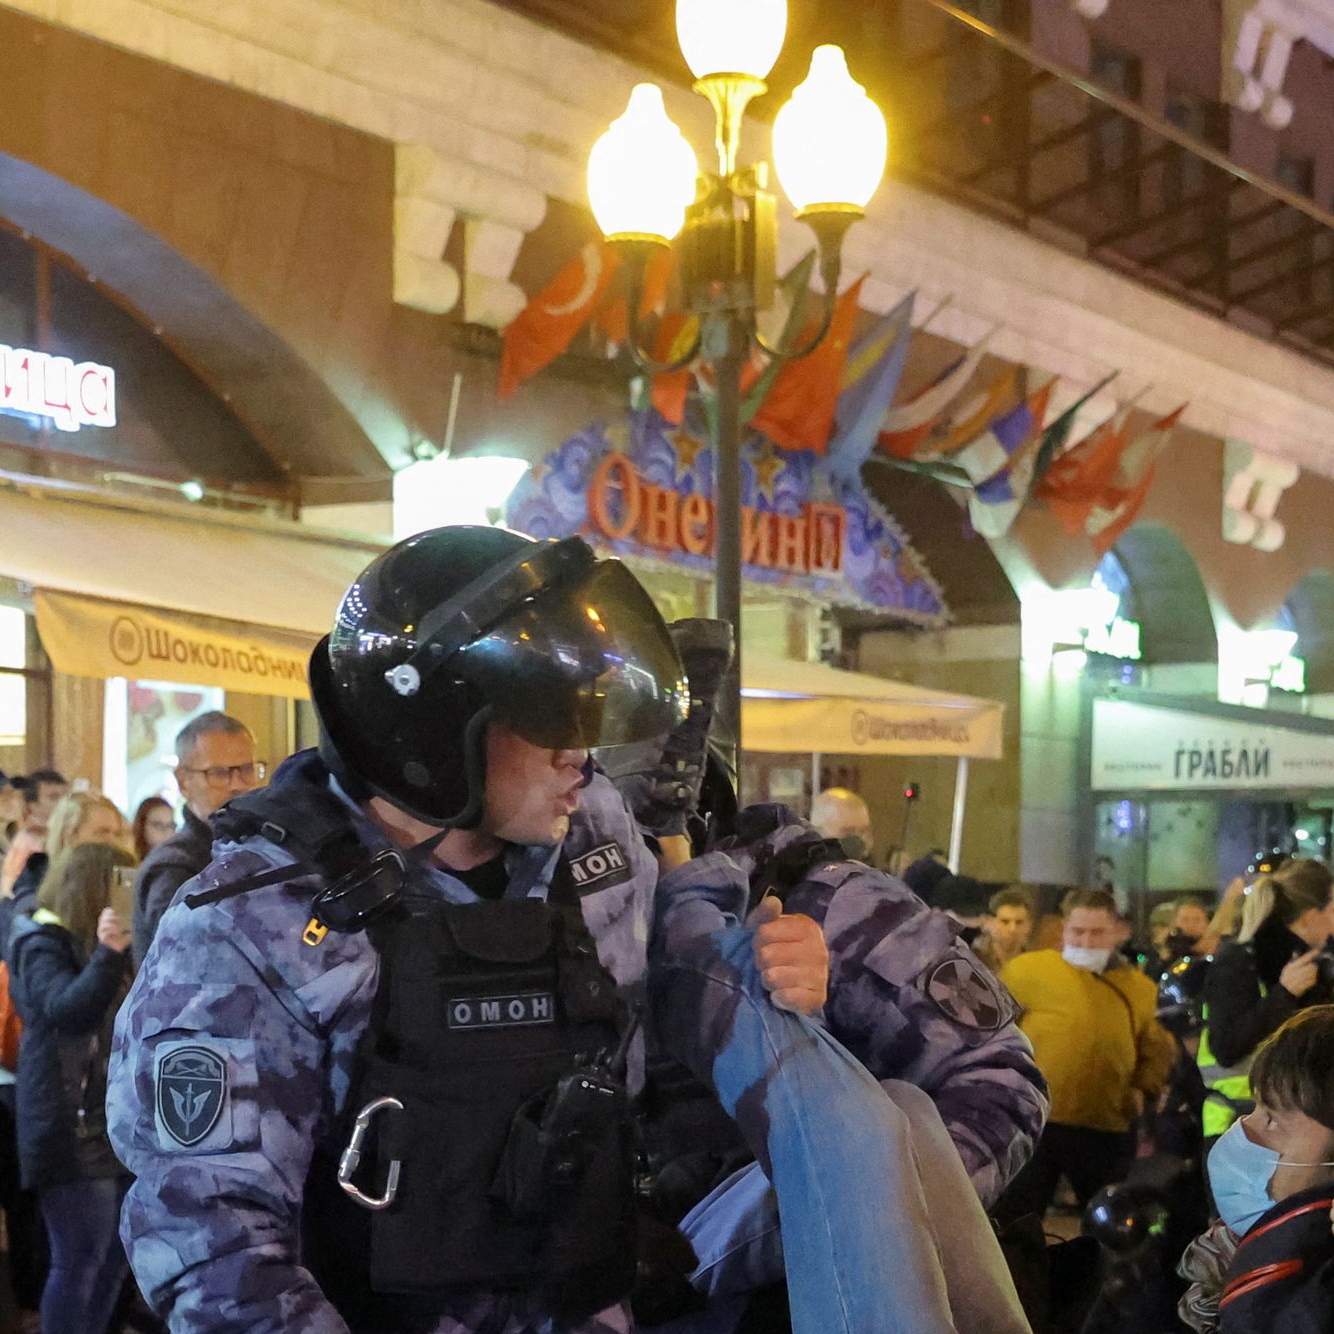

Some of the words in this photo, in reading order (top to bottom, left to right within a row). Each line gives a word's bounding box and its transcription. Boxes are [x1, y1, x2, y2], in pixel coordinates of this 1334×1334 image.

[1173, 747, 1270, 780] ГРАБЛИ
[571, 848, 623, 882] МОН
[454, 998, 548, 1024] ОМОН
